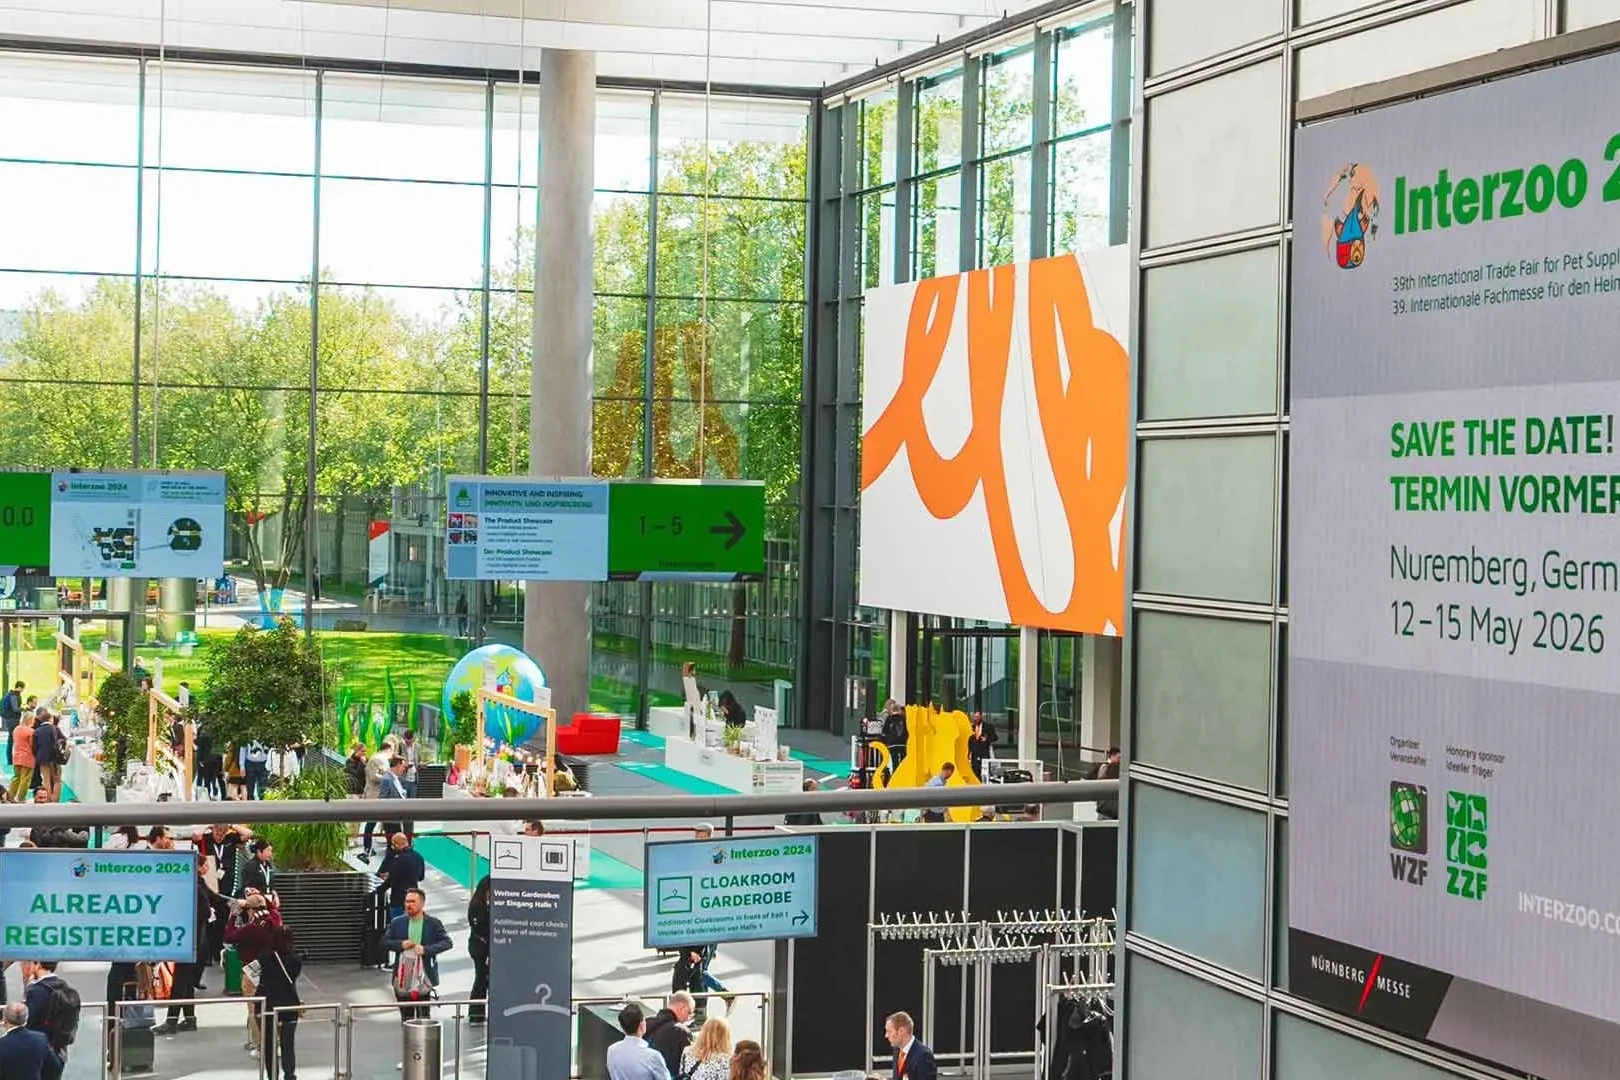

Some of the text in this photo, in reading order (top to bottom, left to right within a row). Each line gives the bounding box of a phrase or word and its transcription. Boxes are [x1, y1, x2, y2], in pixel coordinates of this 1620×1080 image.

[1393, 158, 1588, 235] Interzoo
[1393, 275, 1416, 292] 39th
[1418, 266, 1483, 288] International
[1487, 264, 1516, 280] Trade
[1520, 260, 1539, 275] Fair
[1543, 256, 1560, 273] for
[1563, 254, 1583, 270] Pet
[1393, 300, 1408, 315] 39.
[1411, 291, 1480, 313] Internationale
[1484, 284, 1544, 305] Fachmesse
[1548, 280, 1564, 298] für
[1568, 278, 1590, 296] den
[1391, 414, 1614, 458] SAVE THE DATE!
[1390, 475, 1490, 512] TERMIN
[1390, 544, 1536, 597] Nuremberg,
[1471, 605, 1523, 656] May
[1533, 610, 1604, 654] 2026
[1390, 736, 1420, 750] Organizer
[1446, 745, 1506, 764] Honorary sponsor
[1472, 764, 1494, 779] Träger
[730, 844, 812, 860] Interzoo 2024
[94, 862, 190, 874] Interzoo 2024
[1390, 853, 1428, 886] WZF
[700, 872, 796, 890] CLOAKROOM
[1446, 865, 1488, 900] ZZF
[30, 894, 164, 914] ALREADY
[494, 890, 560, 899] Weitere Garderoben
[506, 900, 533, 908] Eingang
[700, 891, 792, 909] GARDEROBE
[494, 918, 528, 926] Additional
[530, 920, 544, 928] coat
[657, 918, 693, 927] Additional
[694, 915, 734, 925] Cloakrooms
[762, 912, 770, 920] of
[686, 924, 726, 935] Garderoben
[740, 922, 758, 931] Halle
[6, 926, 186, 946] REGISTERED?
[1311, 955, 1411, 999] NÜRNBERG MESSE
